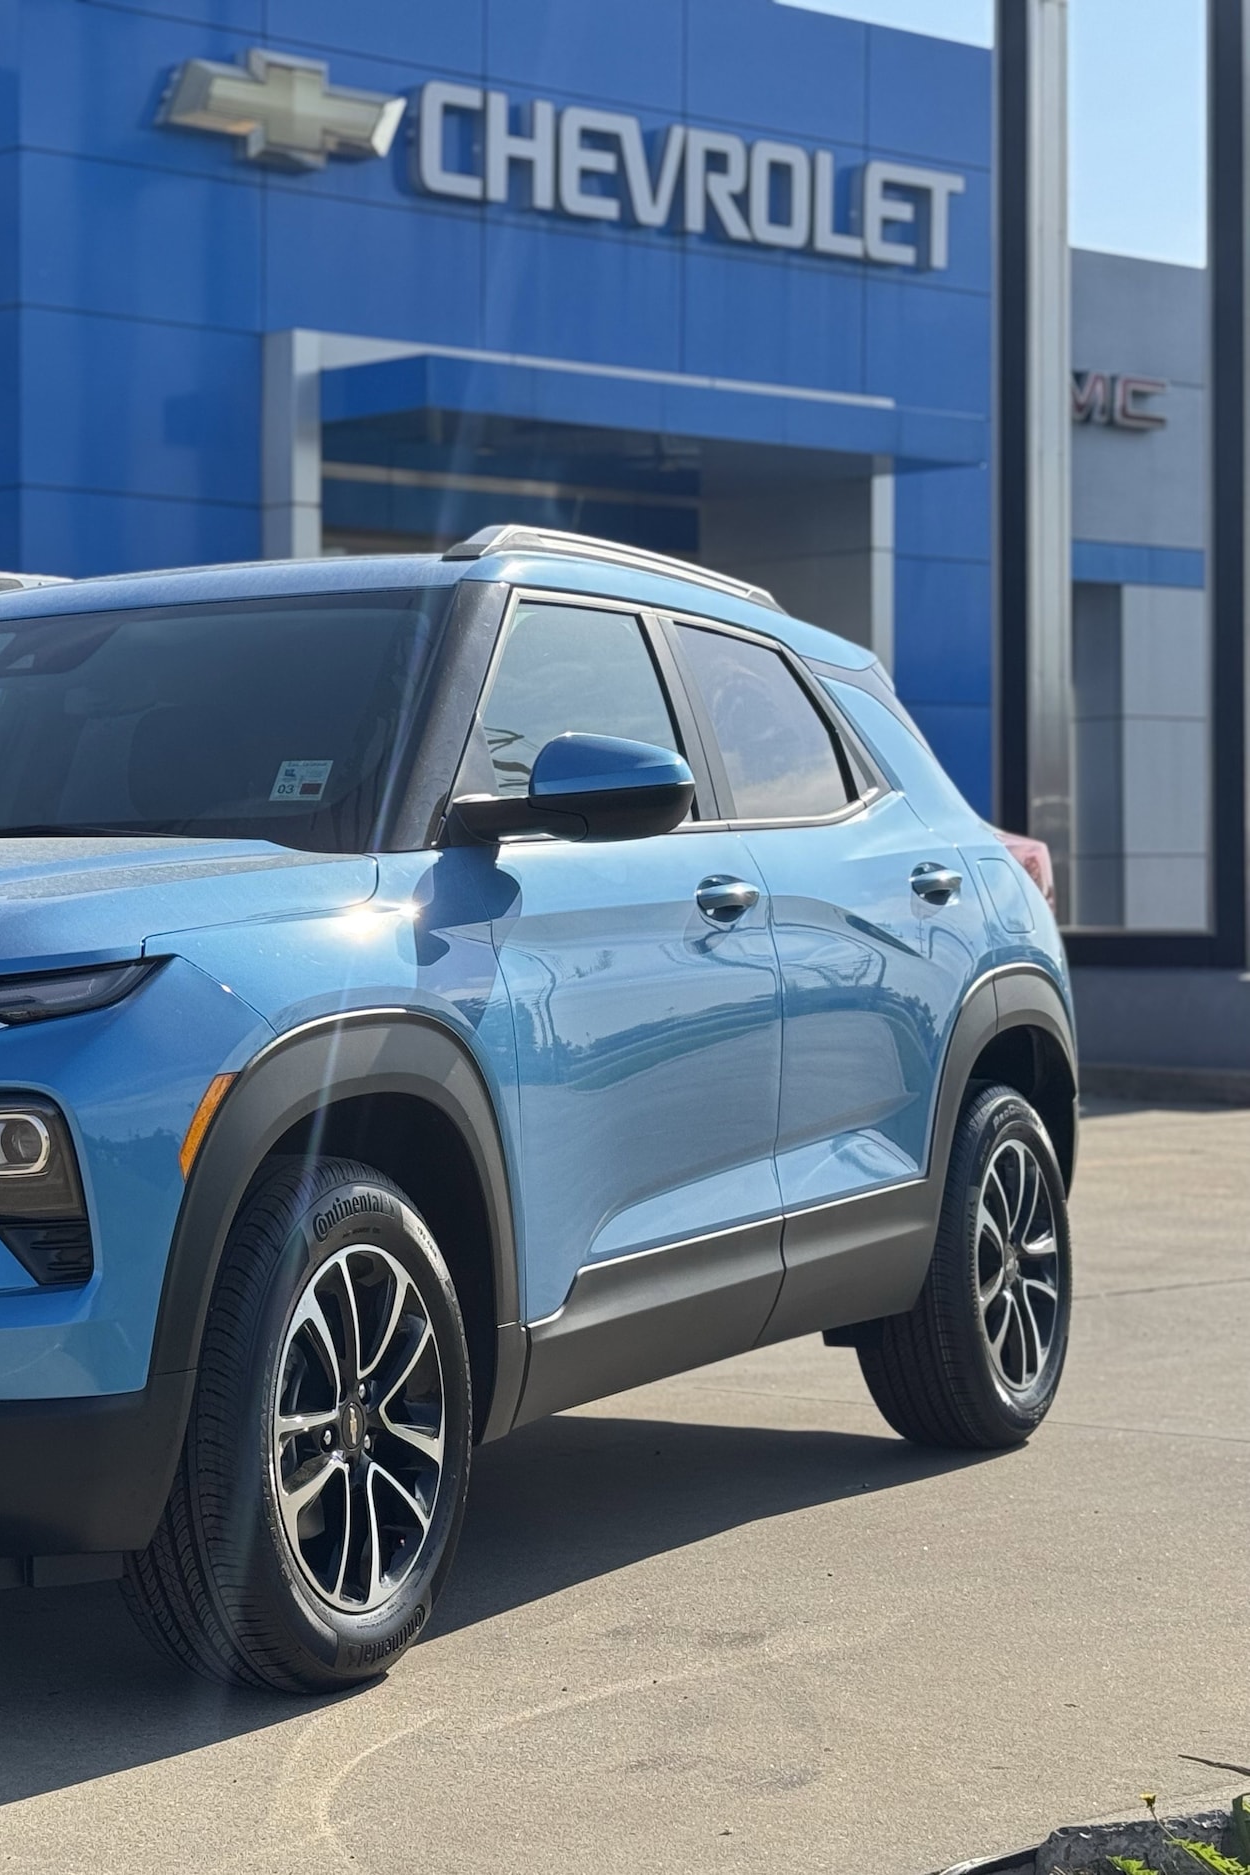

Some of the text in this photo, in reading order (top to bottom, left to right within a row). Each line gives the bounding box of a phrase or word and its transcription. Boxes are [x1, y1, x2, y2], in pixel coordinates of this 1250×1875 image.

[420, 80, 965, 270] CHEVROLET
[1070, 372, 1168, 432] MC
[312, 1191, 385, 1243] Continental
